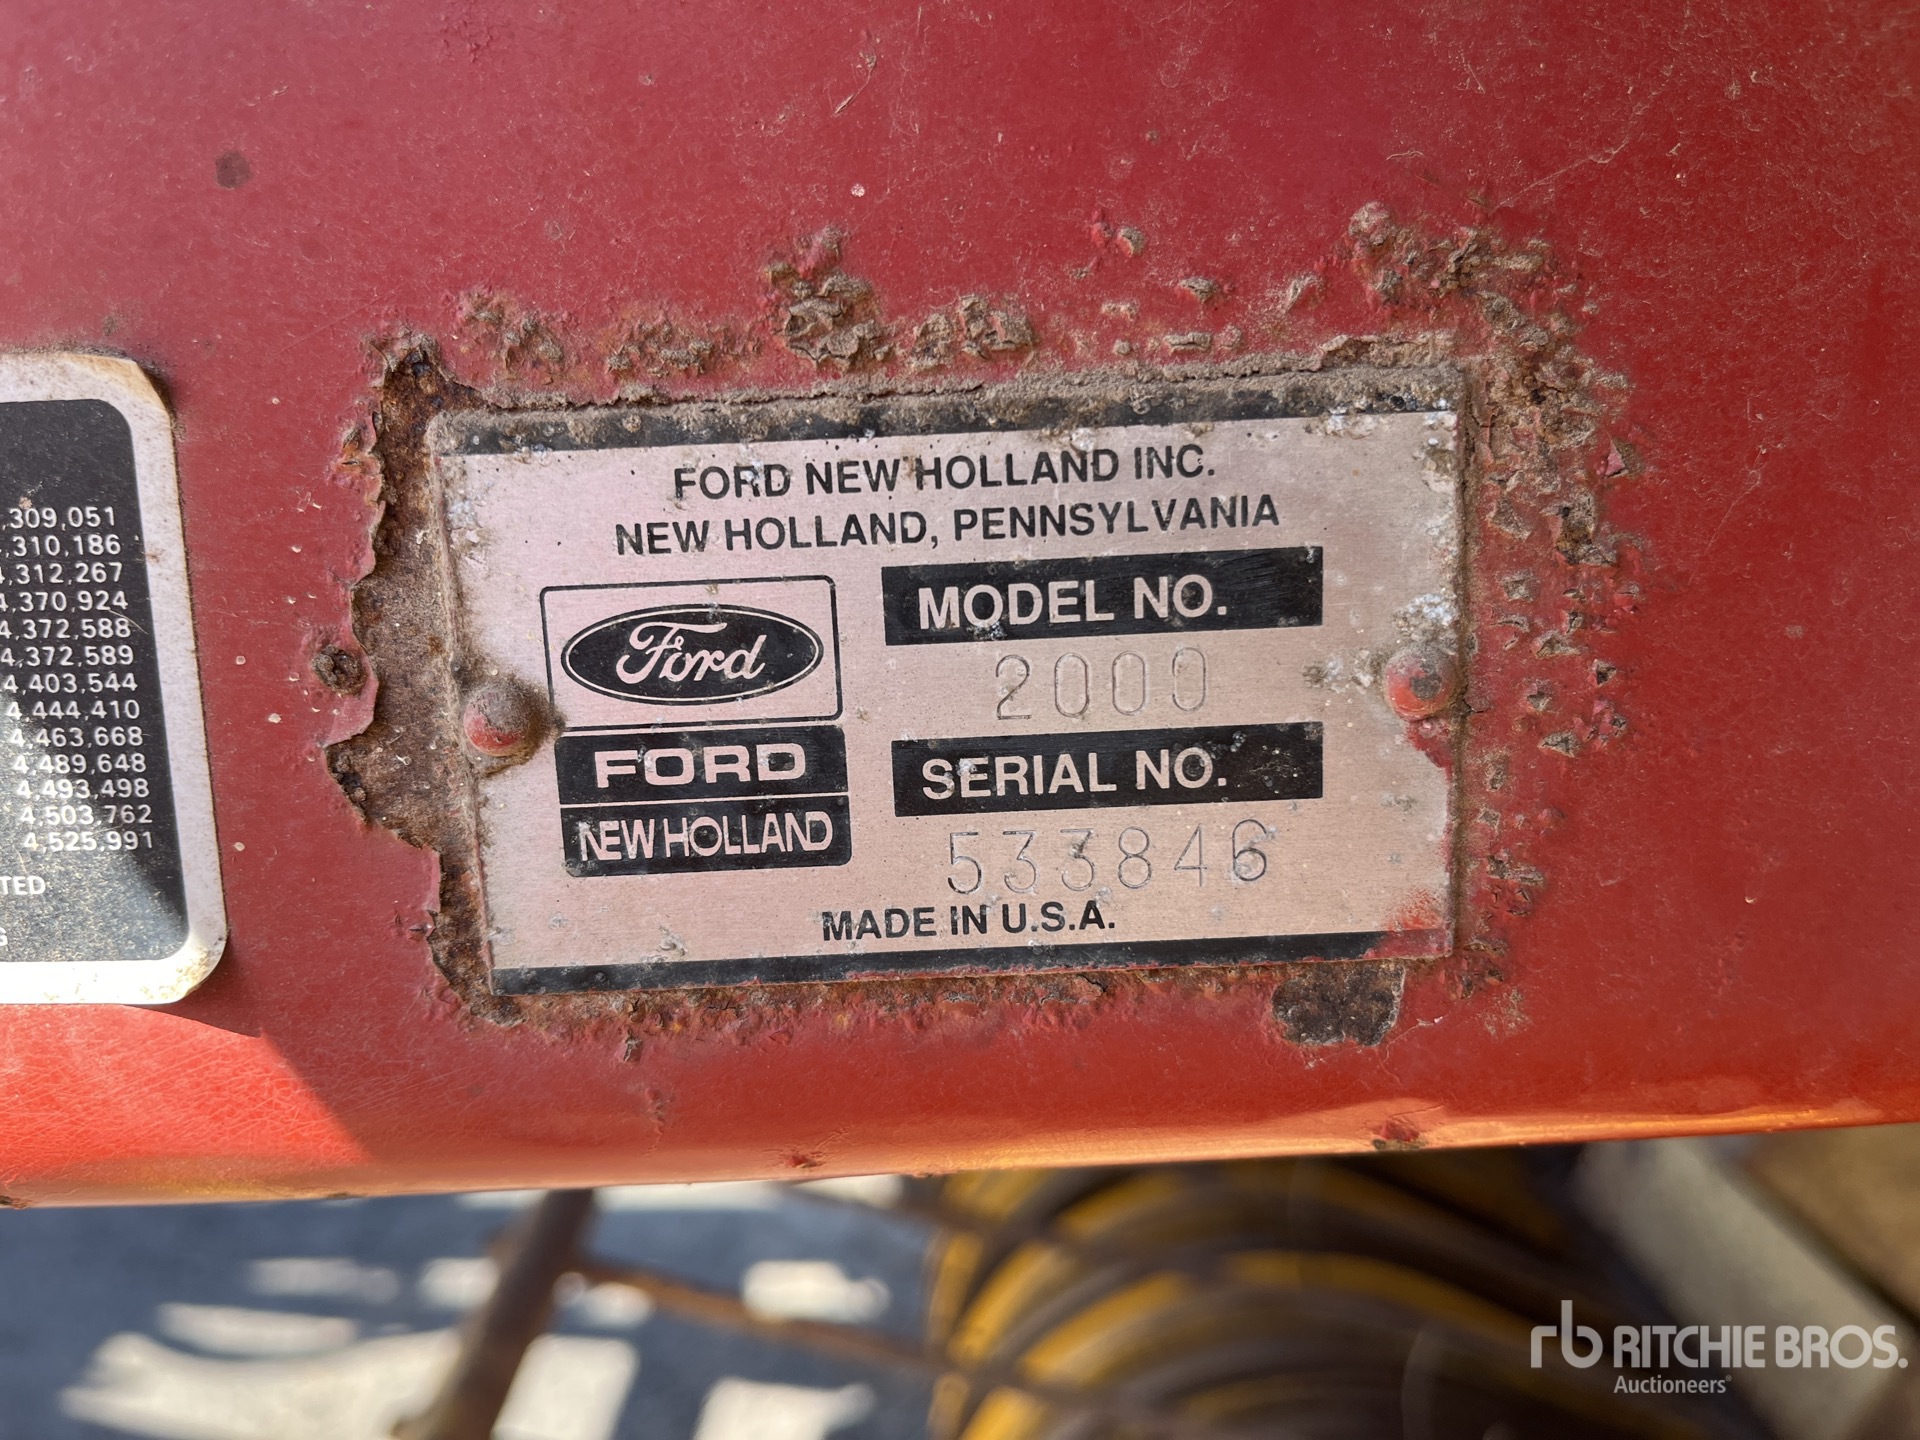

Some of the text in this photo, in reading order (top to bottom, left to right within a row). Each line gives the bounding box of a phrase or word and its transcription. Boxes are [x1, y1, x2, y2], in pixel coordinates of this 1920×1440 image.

[674, 443, 1216, 500] FORD NEW HOLLAND INC.
[616, 494, 1280, 556] NEW HOLLAND, PENNSYLVANIA
[917, 574, 1228, 630] MODEL NO.
[0, 618, 131, 641] 4,372,588
[0, 645, 134, 668] 4,372,589
[616, 621, 767, 684] Ford
[4, 672, 138, 695] 4,403,544
[996, 647, 1207, 720] 2000
[7, 700, 141, 723] 4,444,410
[10, 726, 144, 750] 4,463,668
[13, 753, 147, 775] 4,489,648
[594, 743, 806, 789] FORD
[921, 747, 1228, 800] SERIAL NO.
[16, 778, 150, 801] 4,493,498
[20, 804, 153, 826] 4,503,762
[577, 810, 833, 861] NEW HOLLAND
[23, 831, 153, 853] 4,525,991
[947, 819, 1269, 895] 533846
[821, 901, 1116, 942] MADE IN U.S.A.
